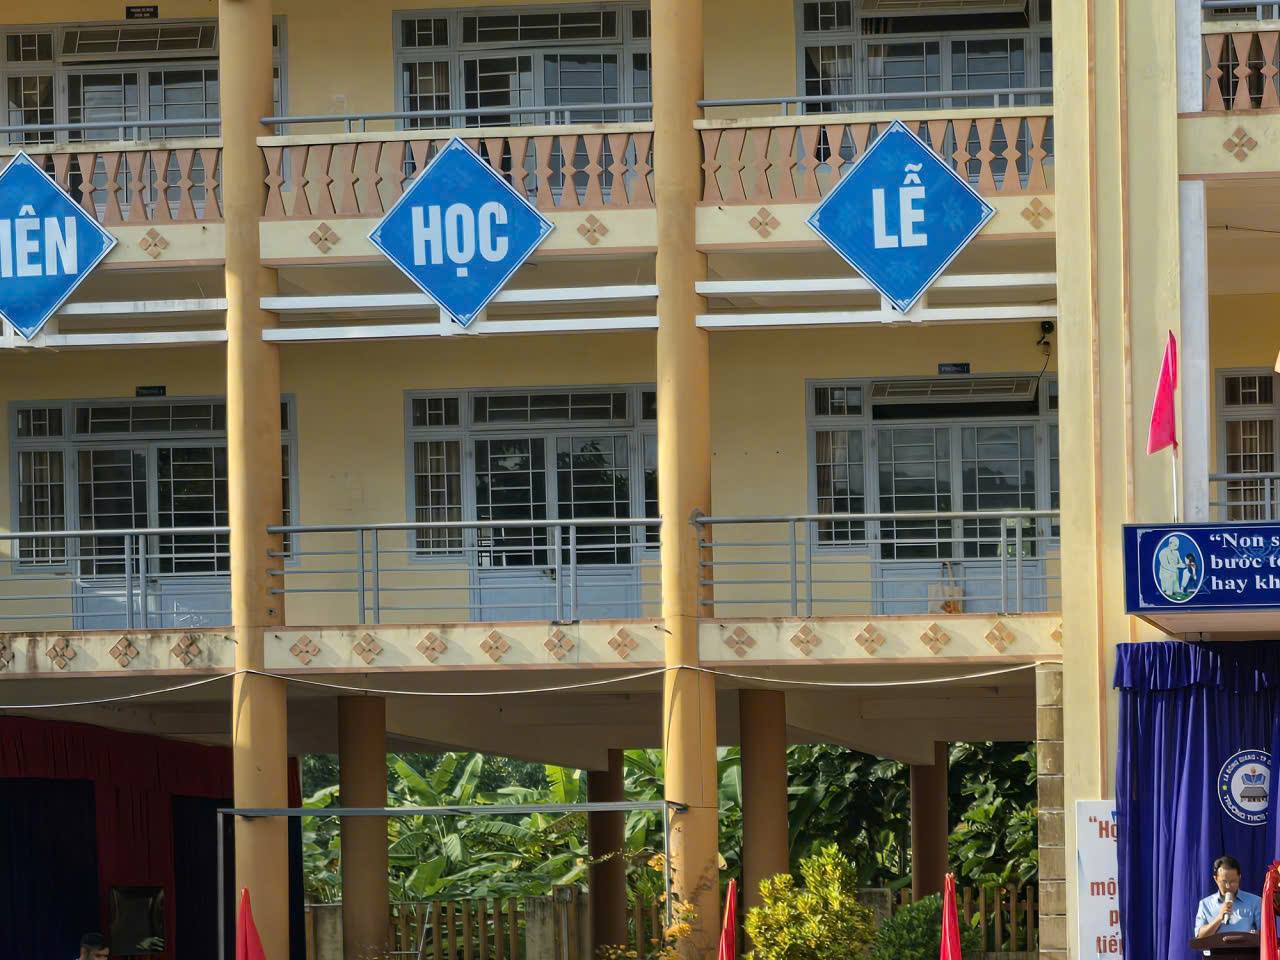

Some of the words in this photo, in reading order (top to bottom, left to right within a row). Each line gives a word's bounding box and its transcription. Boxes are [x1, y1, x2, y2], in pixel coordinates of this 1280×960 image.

[872, 162, 928, 249] LỄ
[0, 204, 78, 278] IÊN
[411, 201, 509, 278] HỌC
[1210, 554, 1262, 569] bước
[1211, 575, 1248, 594] hay
[1089, 816, 1118, 842] “Họ
[1090, 877, 1116, 900] mộ
